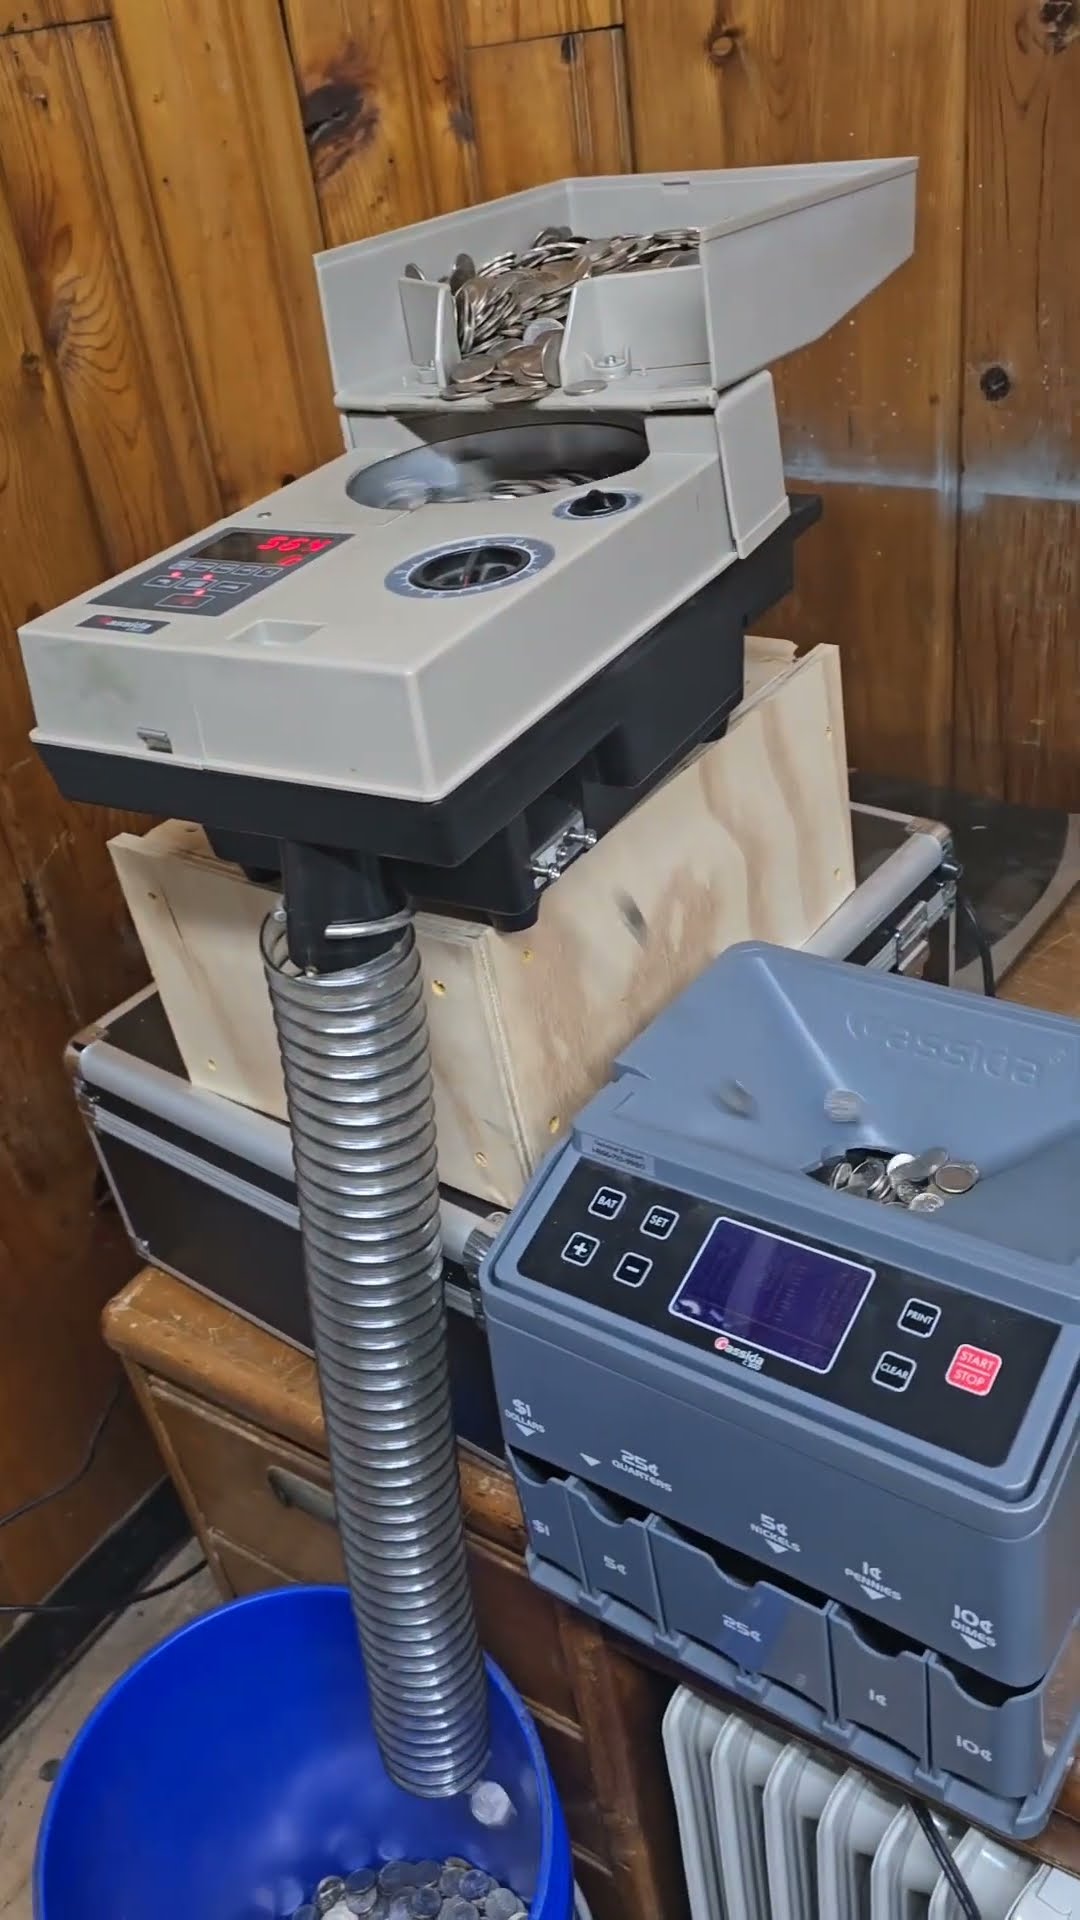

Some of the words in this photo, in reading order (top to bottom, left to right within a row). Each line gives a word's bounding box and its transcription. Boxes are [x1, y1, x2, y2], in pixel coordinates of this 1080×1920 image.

[597, 1196, 618, 1209] BAT
[649, 1215, 669, 1228] SET
[906, 1309, 934, 1325] PRINT
[714, 1337, 764, 1366] Cassida
[960, 1351, 995, 1371] START
[880, 1362, 909, 1380] CLEAR
[954, 1370, 985, 1386] STOP
[512, 1399, 531, 1417] $1
[504, 1409, 545, 1433] DOLLARS
[620, 1450, 659, 1477] 25¢
[612, 1459, 672, 1492] QUARTERS
[532, 1519, 550, 1536] $1
[760, 1513, 788, 1536] 5¢
[750, 1523, 800, 1552] NICKELS
[603, 1555, 627, 1575] 5¢
[863, 1561, 882, 1580] 1¢
[844, 1568, 901, 1600] PENNIES
[722, 1614, 761, 1642] 25¢
[954, 1604, 994, 1634] 10¢
[951, 1619, 997, 1648] DIMES
[869, 1689, 887, 1706] 1¢
[956, 1735, 992, 1762] 10¢
